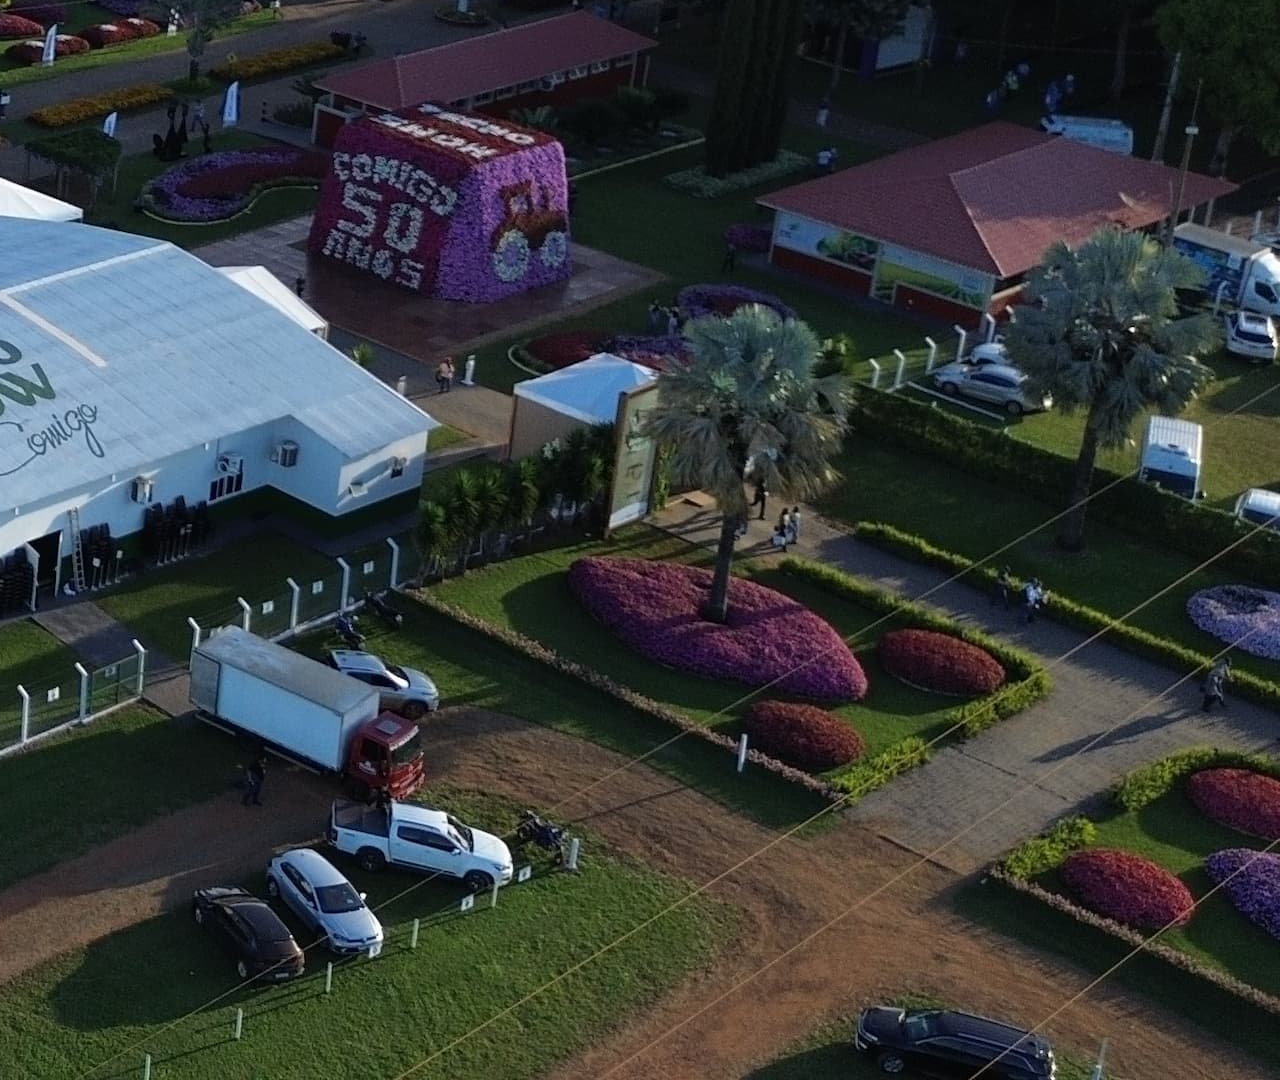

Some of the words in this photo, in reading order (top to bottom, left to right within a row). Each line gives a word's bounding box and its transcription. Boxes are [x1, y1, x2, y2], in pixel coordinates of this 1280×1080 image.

[333, 151, 457, 216] COMIGO
[337, 182, 425, 253] 50
[321, 228, 425, 290] ANOS
